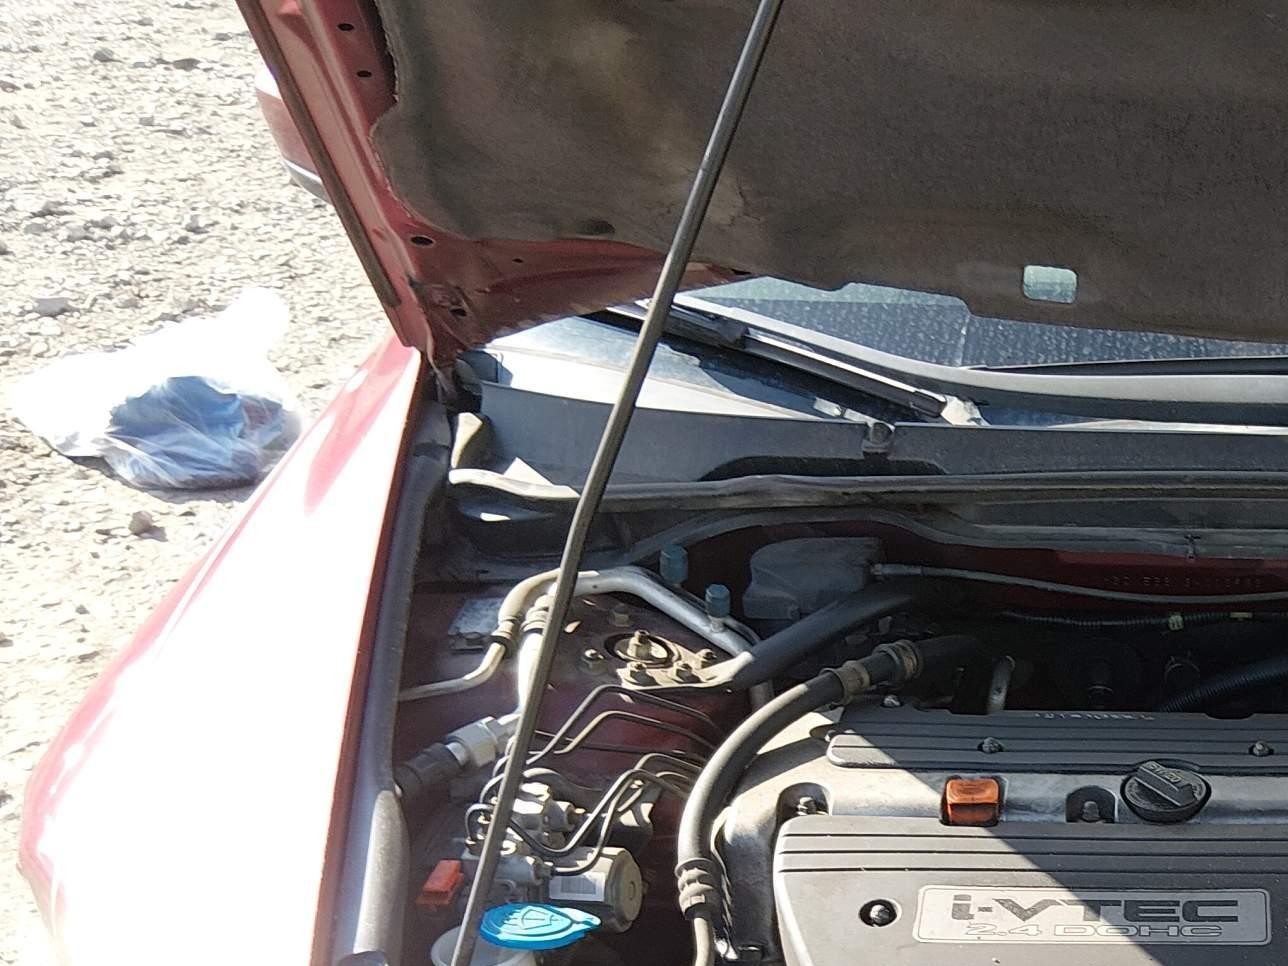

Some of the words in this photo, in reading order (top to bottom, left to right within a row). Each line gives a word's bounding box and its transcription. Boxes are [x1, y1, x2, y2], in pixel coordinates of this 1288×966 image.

[950, 893, 1239, 923] i-VTEC
[965, 923, 1042, 938] 2.4
[1053, 923, 1224, 938] DOHC
